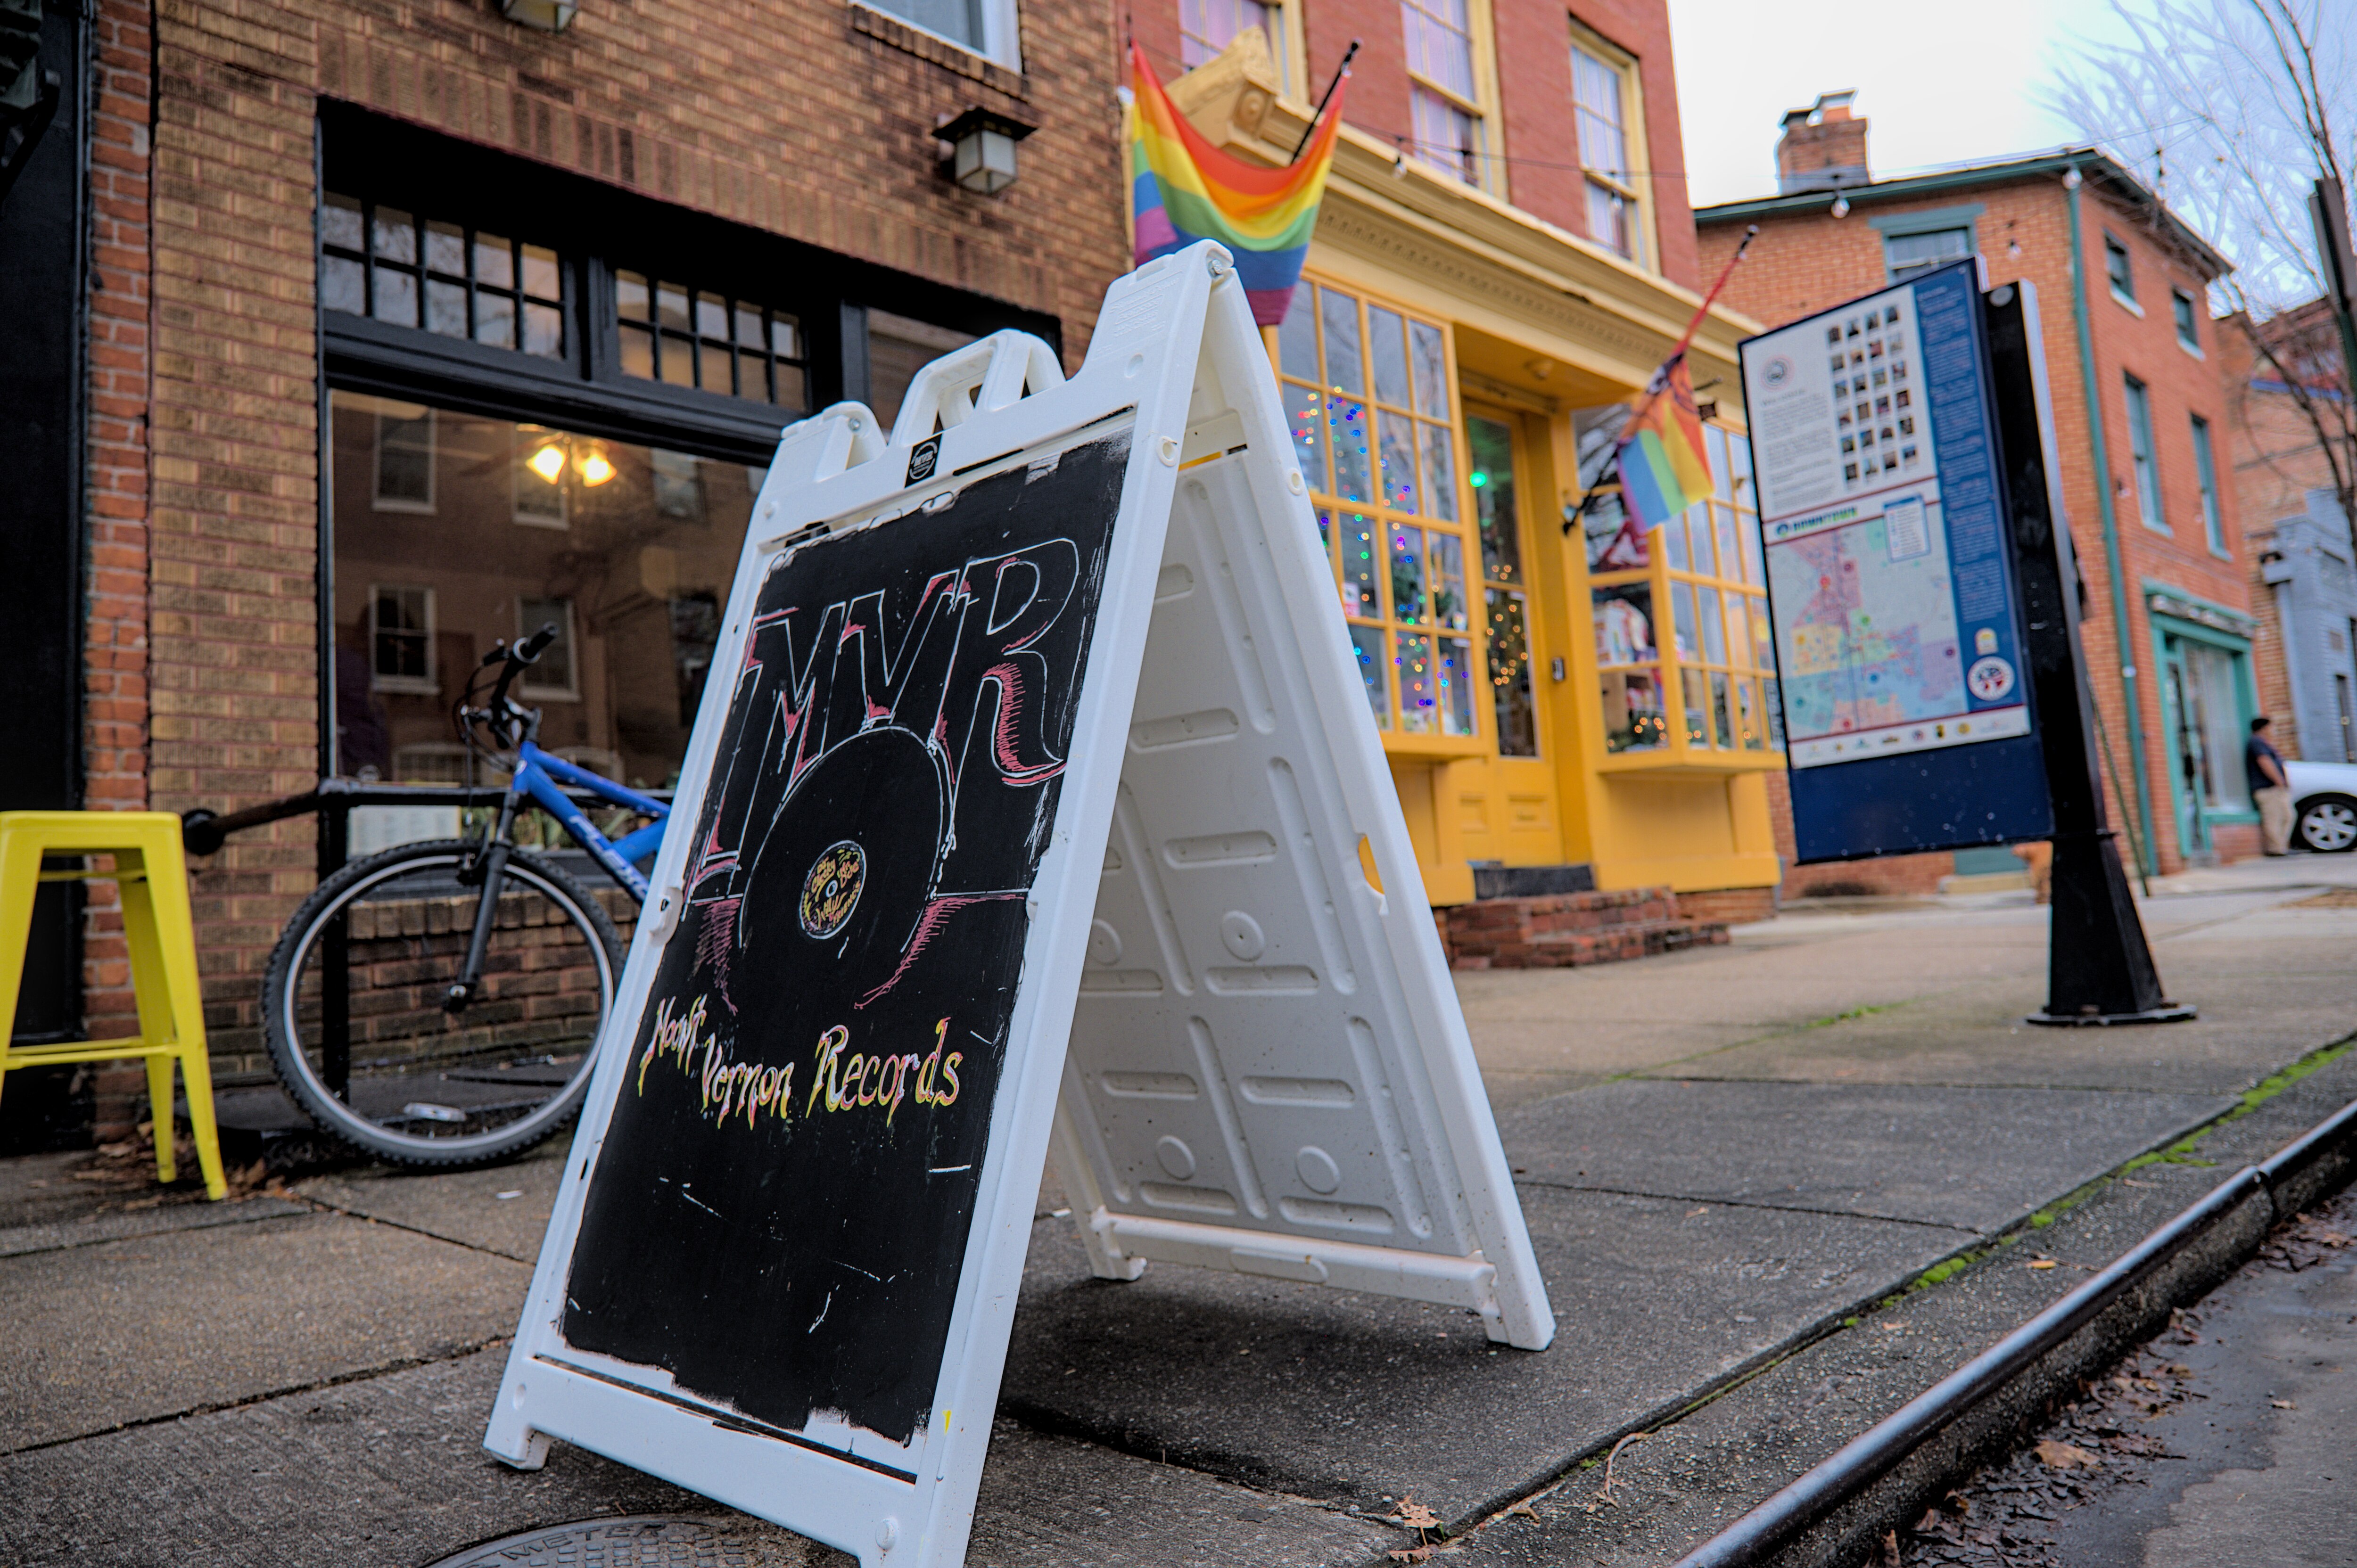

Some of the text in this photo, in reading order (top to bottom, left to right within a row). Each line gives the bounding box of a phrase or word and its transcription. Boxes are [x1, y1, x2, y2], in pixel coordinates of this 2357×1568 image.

[685, 538, 1080, 898] MVR
[701, 1032, 794, 1131] Vernon
[805, 1017, 963, 1128] Records
[500, 1523, 667, 1560] METER
